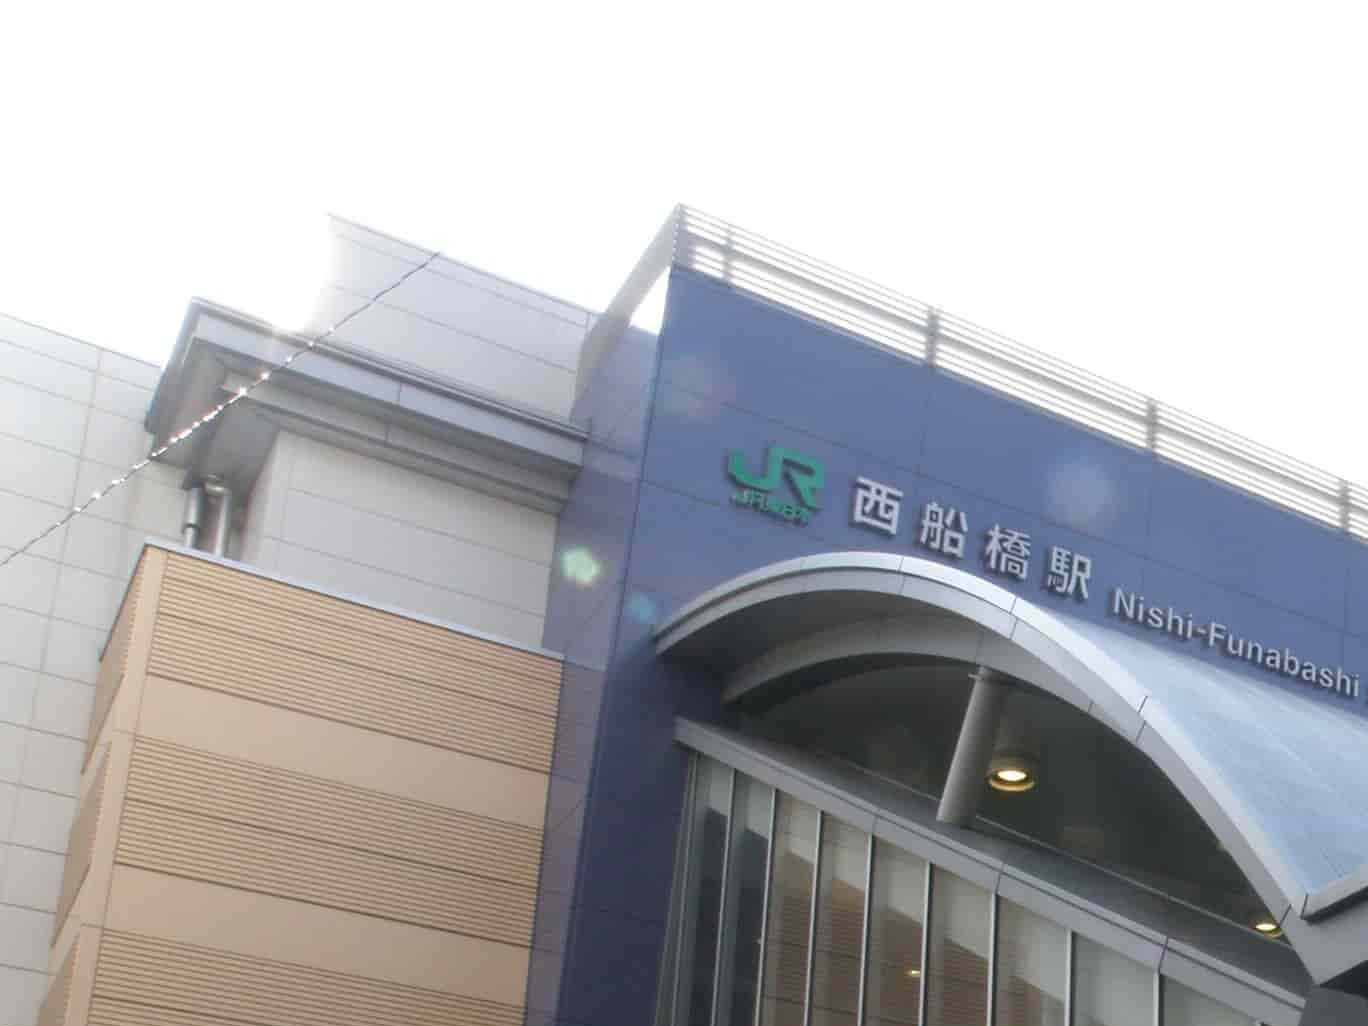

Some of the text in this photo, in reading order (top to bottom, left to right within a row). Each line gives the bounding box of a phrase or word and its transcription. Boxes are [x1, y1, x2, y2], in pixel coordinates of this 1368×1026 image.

[727, 444, 826, 511] JR
[853, 476, 1092, 600] 西船橋駅
[1113, 587, 1360, 698] Nishi-Funabashi
